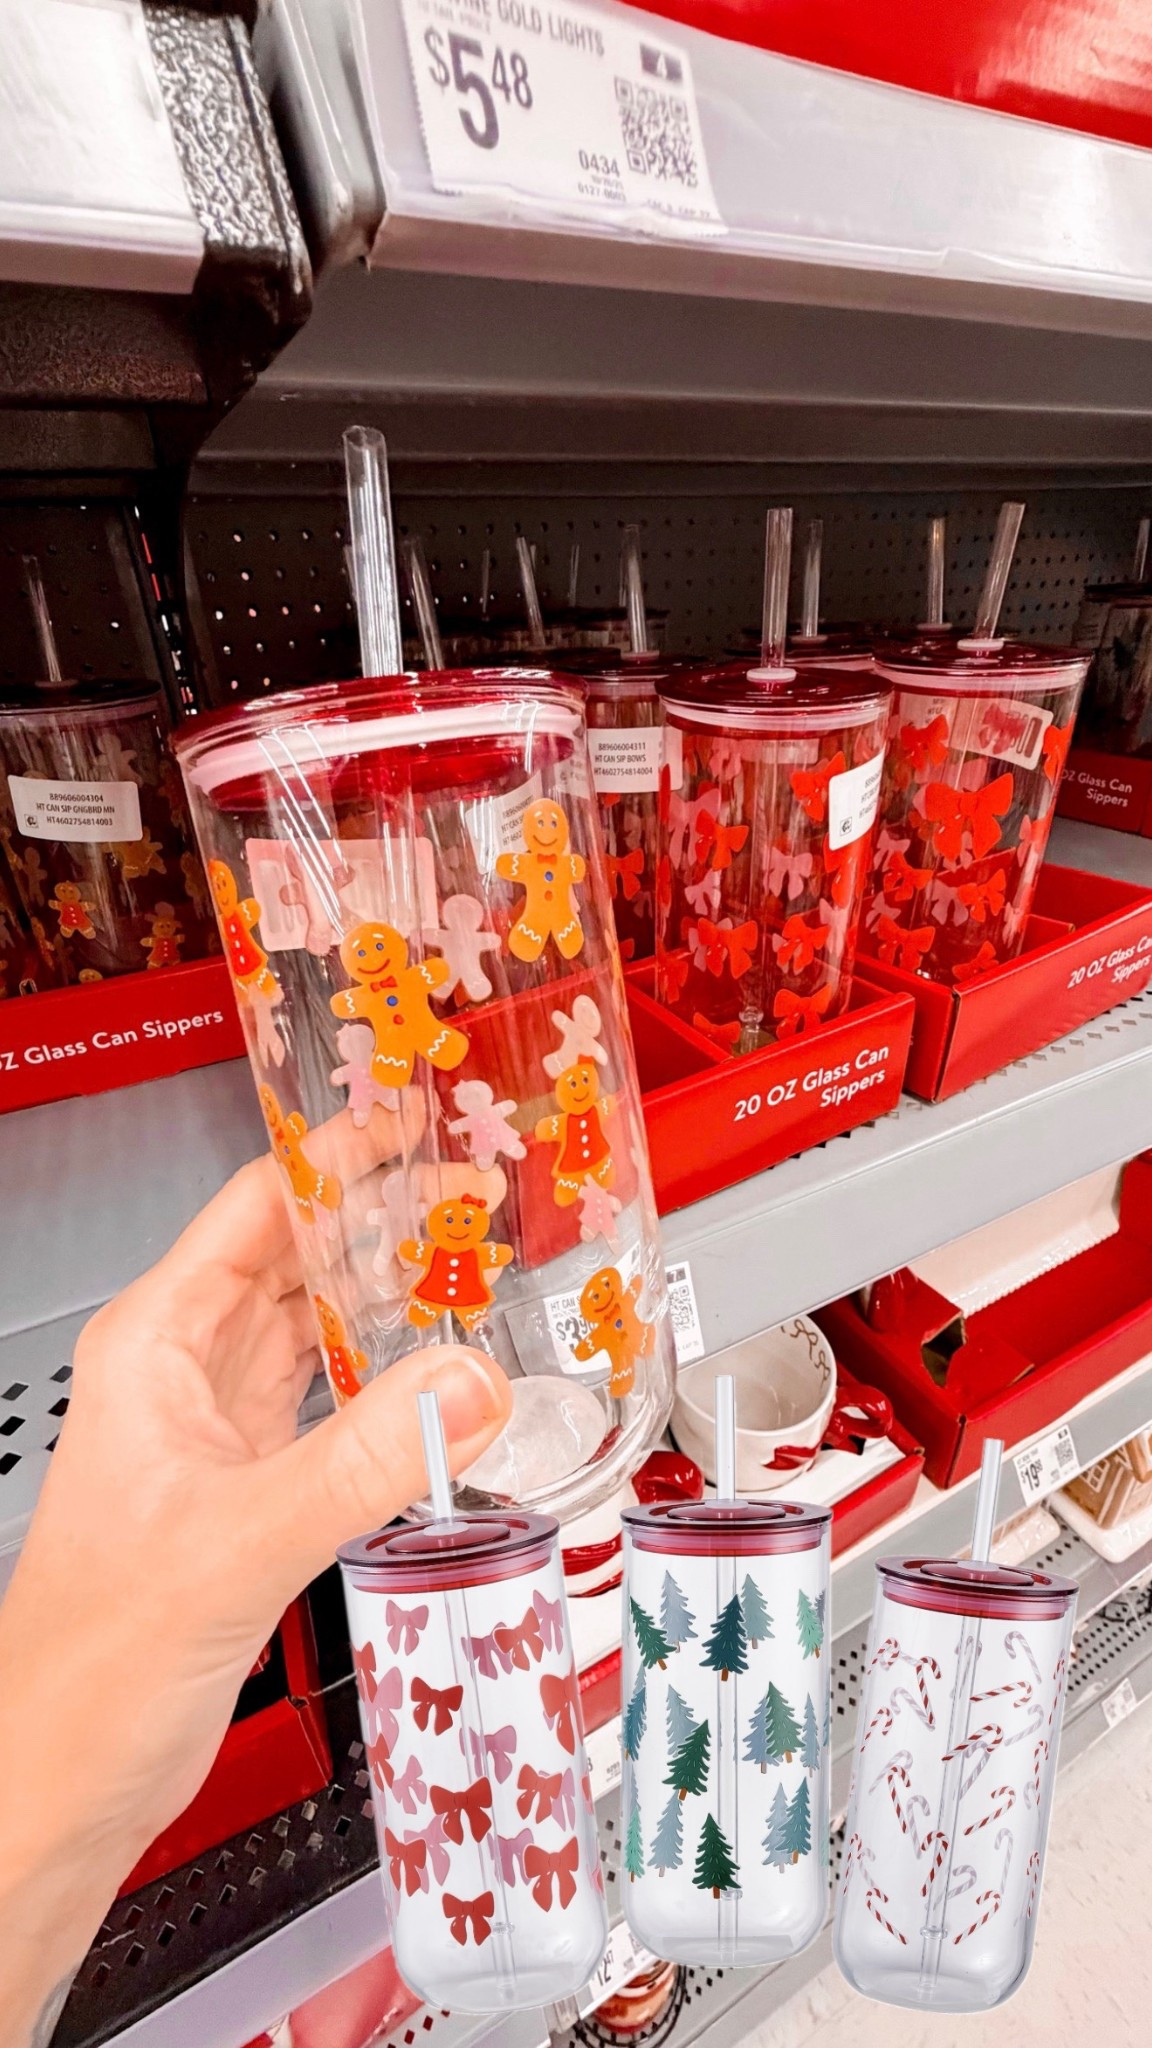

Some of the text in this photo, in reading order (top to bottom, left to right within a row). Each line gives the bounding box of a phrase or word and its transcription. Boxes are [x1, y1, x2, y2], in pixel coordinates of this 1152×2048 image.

[498, 0, 542, 34] GOLD
[548, 12, 604, 57] LIGHTS
[578, 149, 620, 178] 0434
[603, 755, 615, 763] CAN
[616, 755, 626, 763] SIP
[627, 754, 646, 763] BOWS
[1077, 772, 1106, 788] Glass
[1109, 778, 1132, 793] Can
[36, 803, 45, 811] HT
[46, 803, 60, 812] CAN
[61, 804, 72, 813] SIP
[103, 805, 115, 813] MN
[1086, 788, 1128, 807] Sippers
[1067, 936, 1152, 989] 20 OZ Glass Ca
[1111, 955, 1151, 983] Sippers
[24, 1041, 87, 1064] Glass
[92, 1030, 138, 1049] Can
[142, 1011, 224, 1039] Sippers
[733, 1046, 889, 1122] 20 OZ Glass Can
[819, 1069, 886, 1107] Sippers
[551, 1301, 560, 1312] HT
